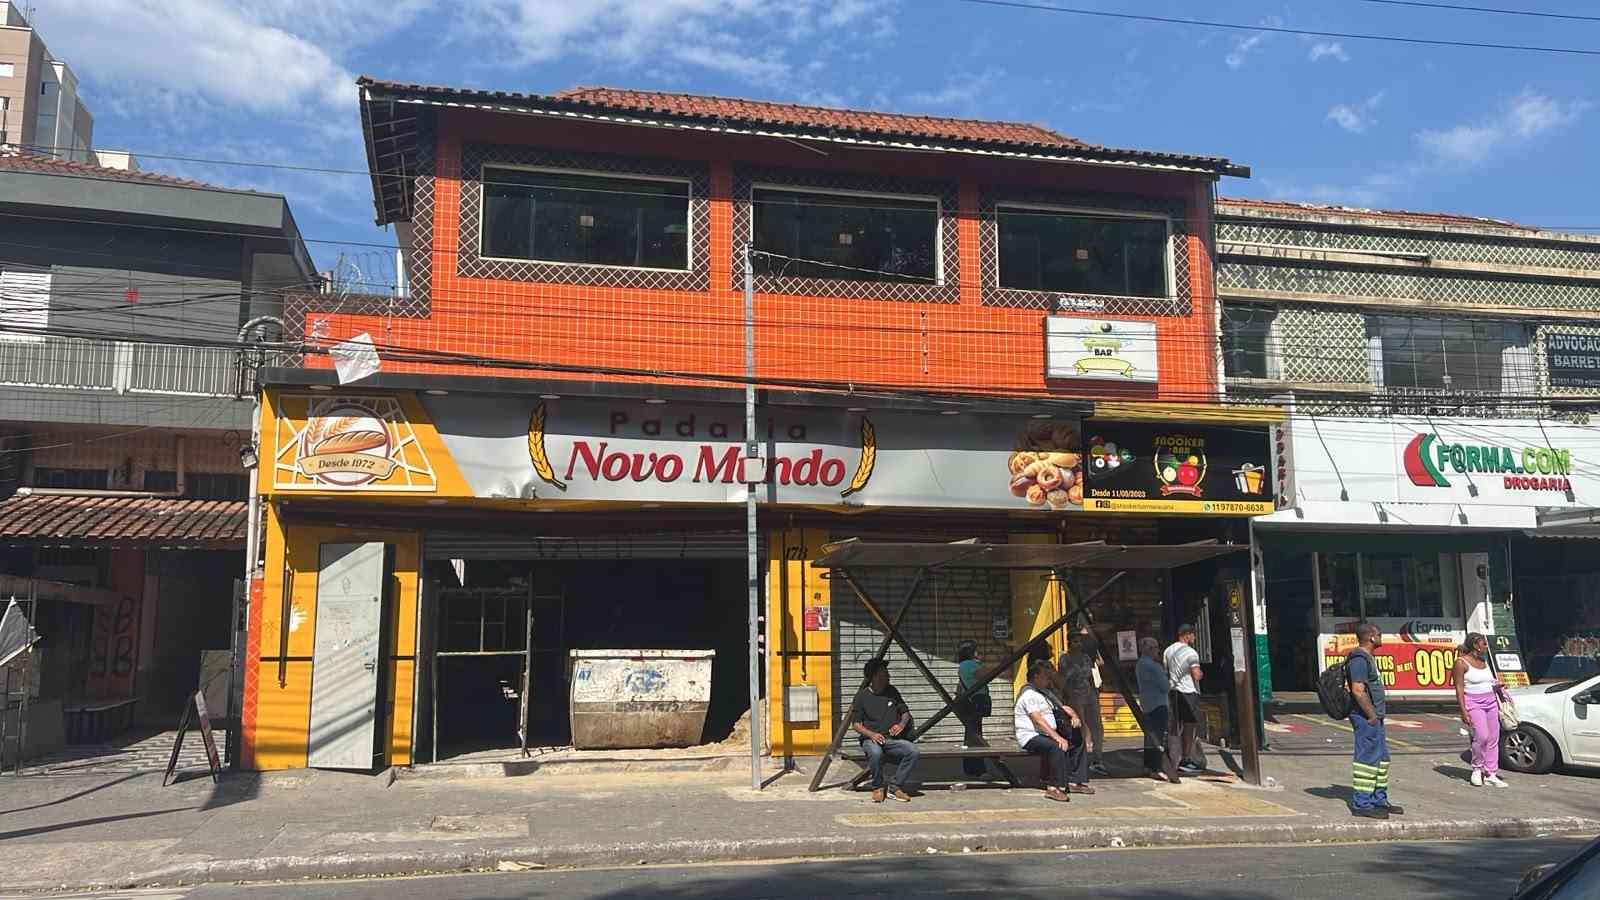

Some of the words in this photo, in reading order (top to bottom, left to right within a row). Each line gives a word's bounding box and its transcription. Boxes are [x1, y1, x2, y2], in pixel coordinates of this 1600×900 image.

[1094, 348, 1112, 356] BAR
[609, 410, 807, 439] Padaia
[318, 459, 350, 469] Desde
[352, 459, 375, 469] 1972
[564, 441, 684, 483] Novo
[1503, 475, 1572, 492] DROGARIA
[578, 670, 592, 681] 47
